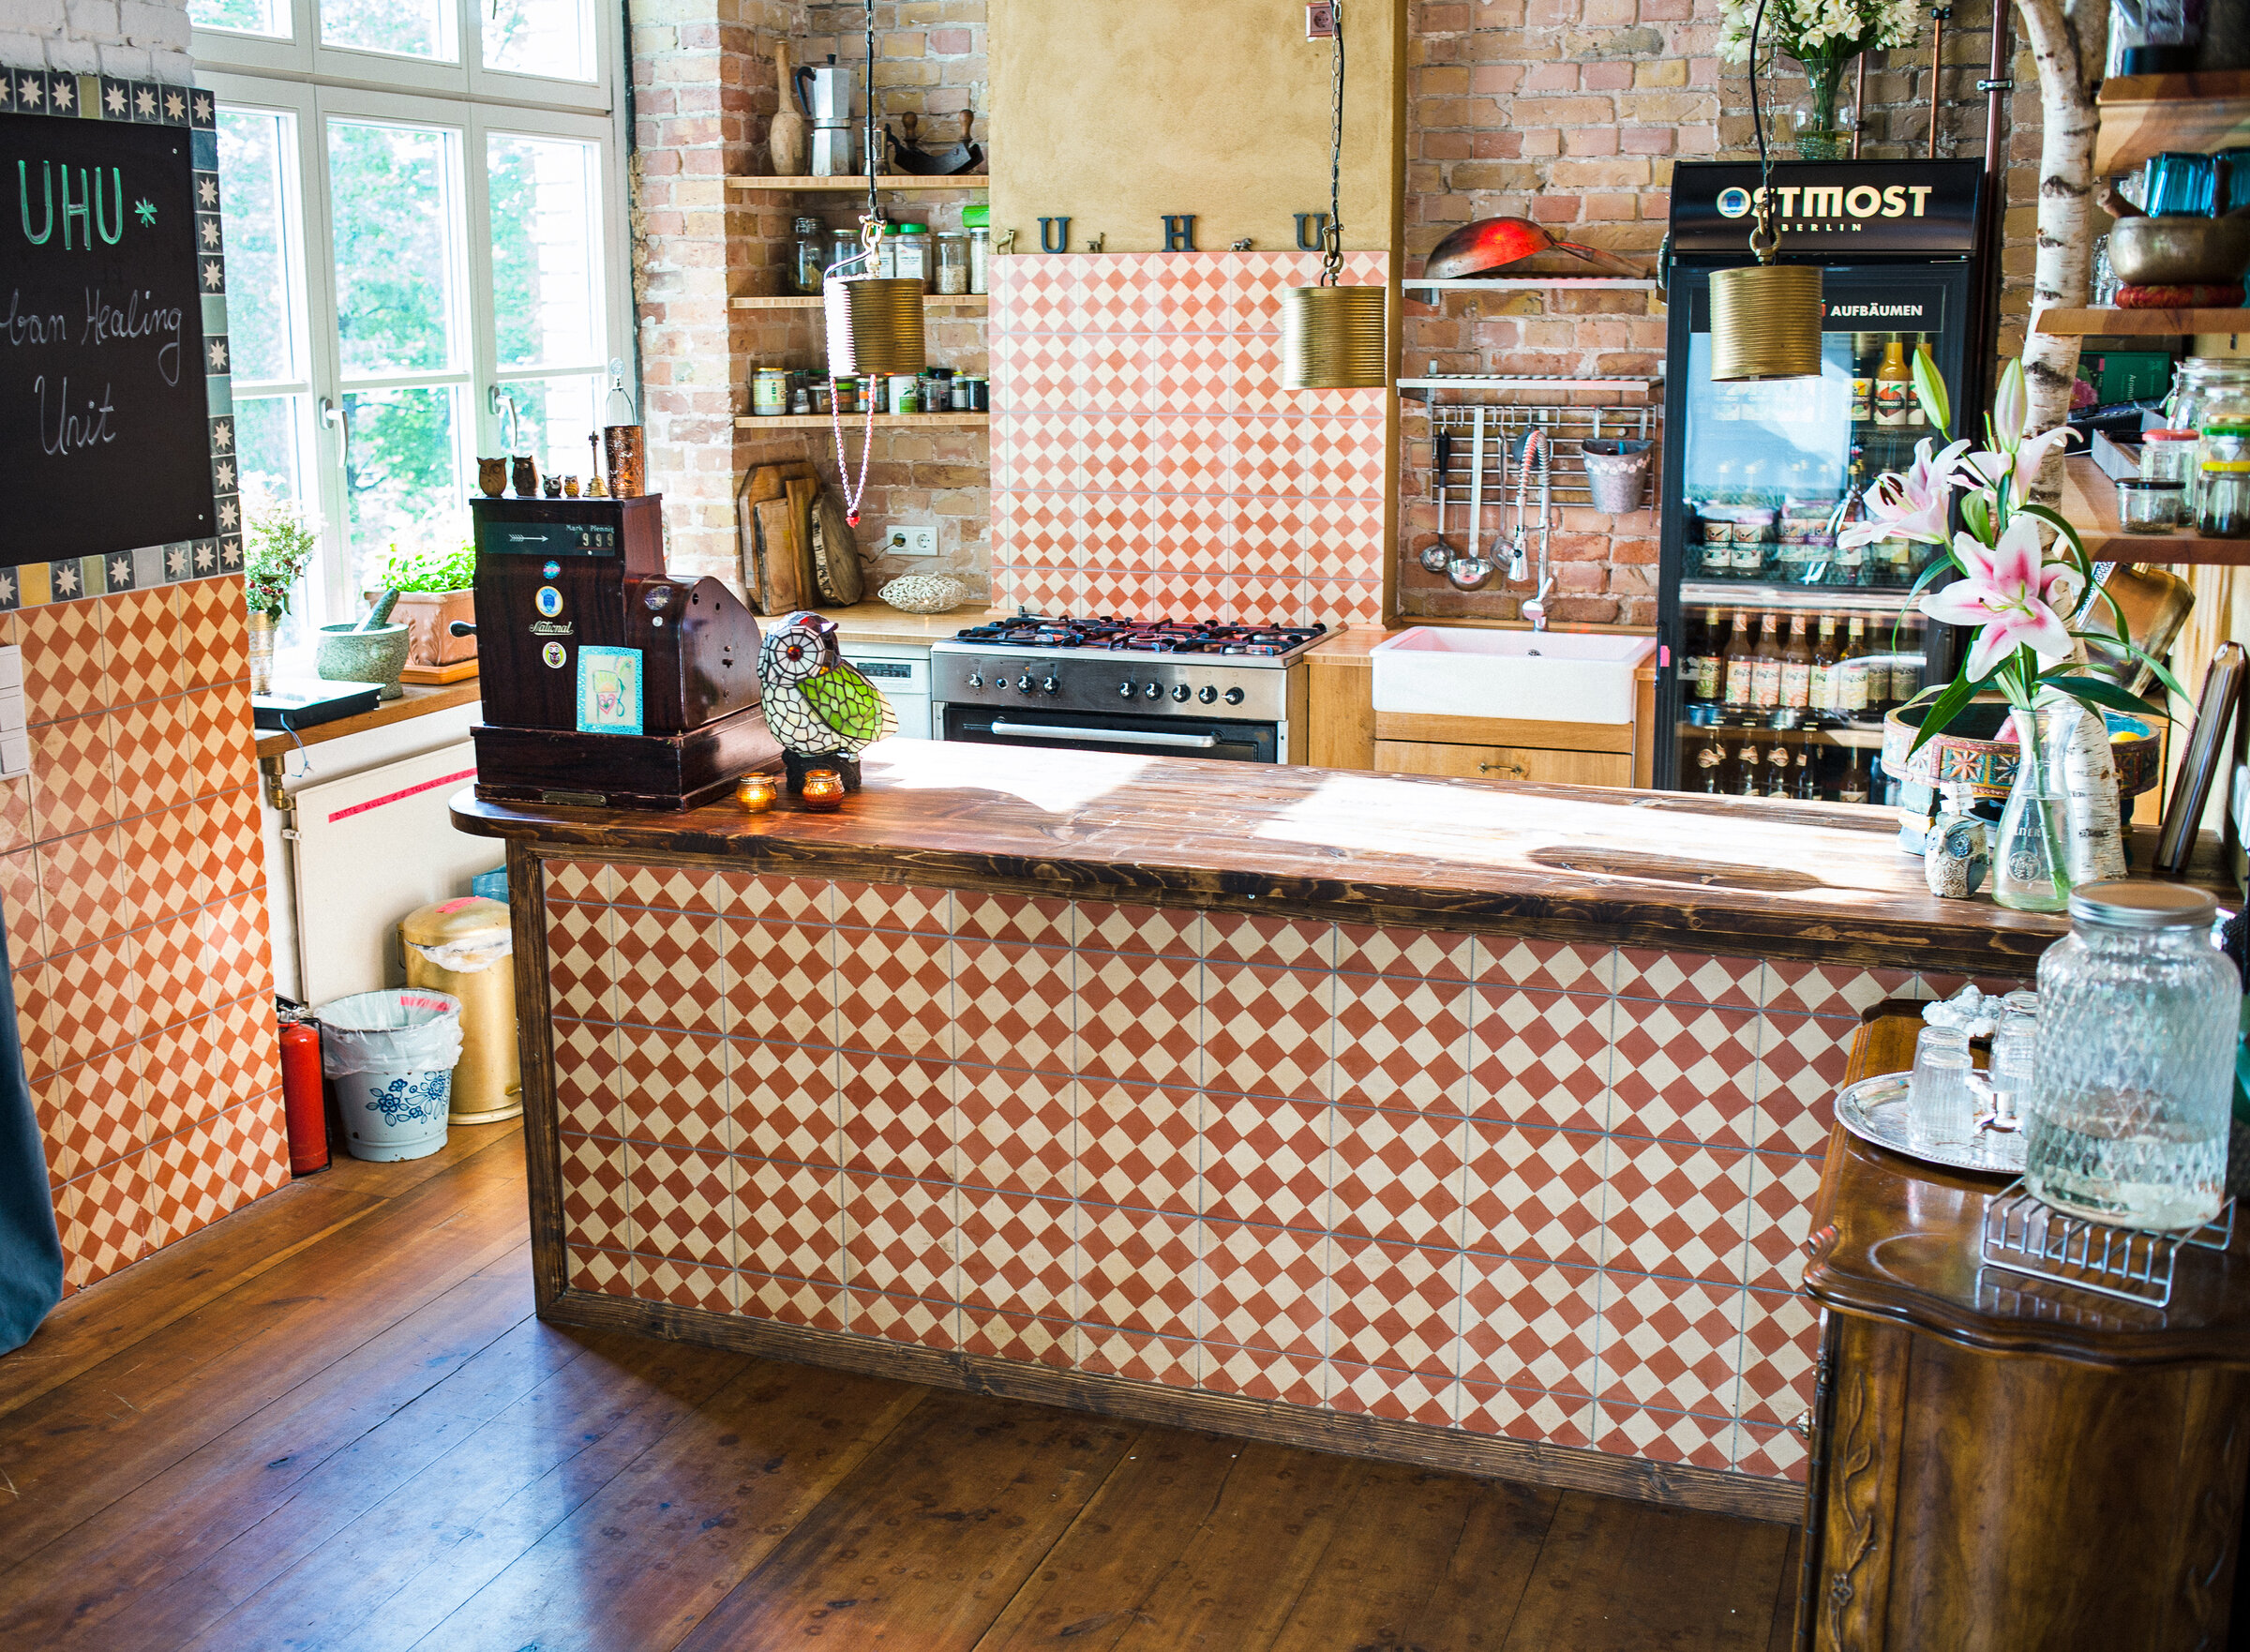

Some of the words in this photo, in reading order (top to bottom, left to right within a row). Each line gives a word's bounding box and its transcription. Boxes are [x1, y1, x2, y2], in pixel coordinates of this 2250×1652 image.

[18, 159, 124, 251] UHU
[1716, 185, 1933, 218] OSTMOST
[1781, 223, 1862, 232] BERLIN
[1830, 302, 1923, 317] AUFBÄUMEN
[81, 286, 182, 387] Healing
[34, 375, 116, 456] Unit
[529, 620, 575, 636] National
